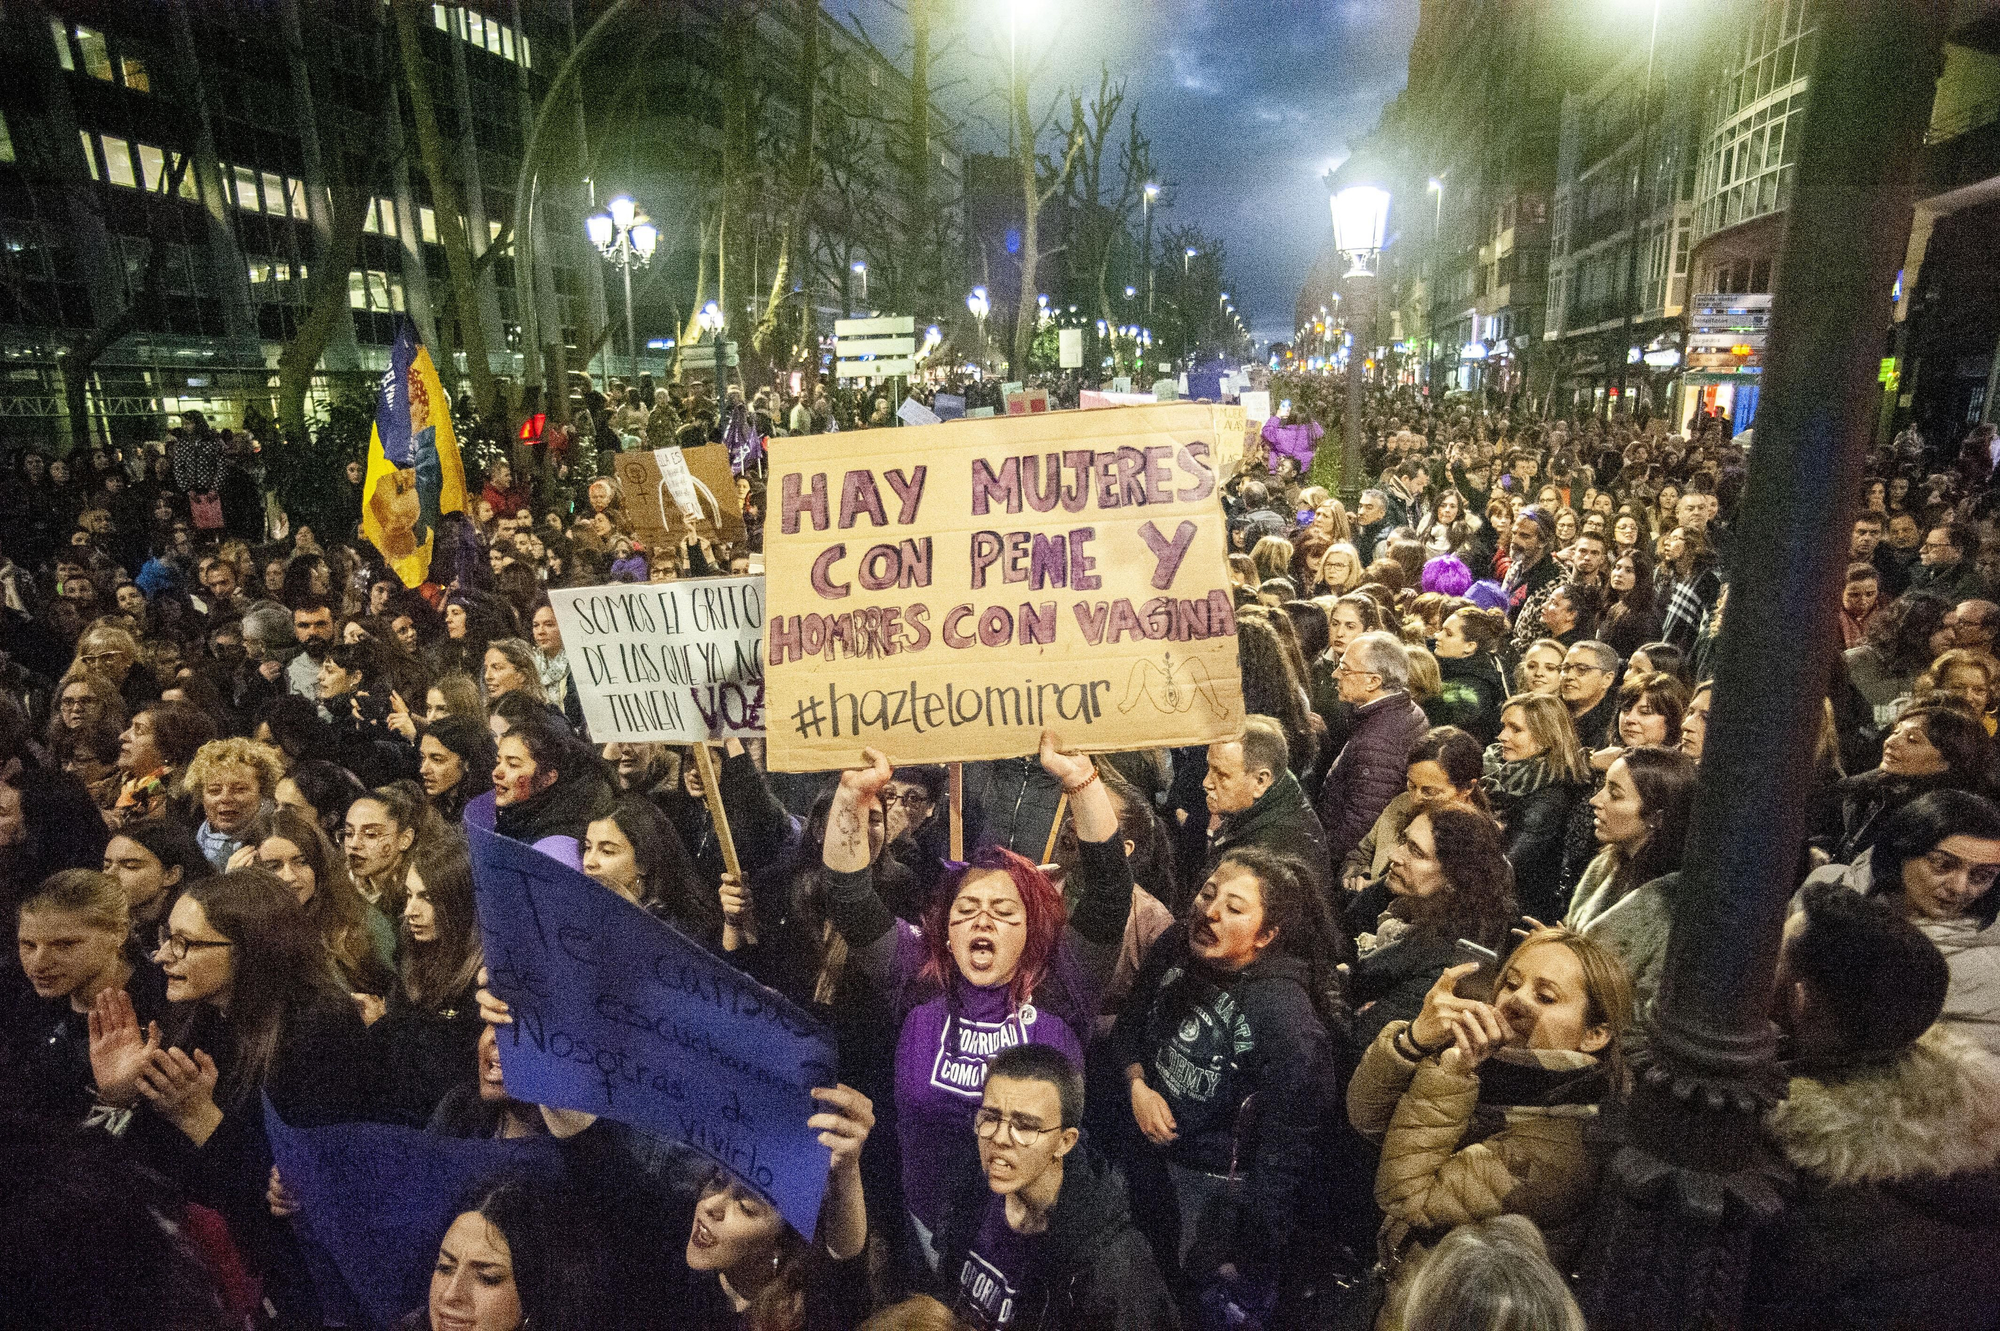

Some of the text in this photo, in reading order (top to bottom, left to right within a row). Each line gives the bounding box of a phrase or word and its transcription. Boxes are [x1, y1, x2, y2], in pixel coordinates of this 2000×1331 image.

[780, 440, 1217, 535] HAY MUJERES
[810, 519, 1199, 600] CON PENE Y
[572, 584, 762, 635] SOMOS EL GRITO
[768, 588, 1238, 667] HOMBRES CON VAGINA
[581, 643, 619, 687] DE
[619, 642, 661, 684] LAS
[661, 643, 701, 687] QUE
[695, 641, 727, 684] YA
[602, 689, 686, 733] TIENEN
[790, 678, 1112, 740] #haztelomirar
[941, 1059, 979, 1087] COMO
